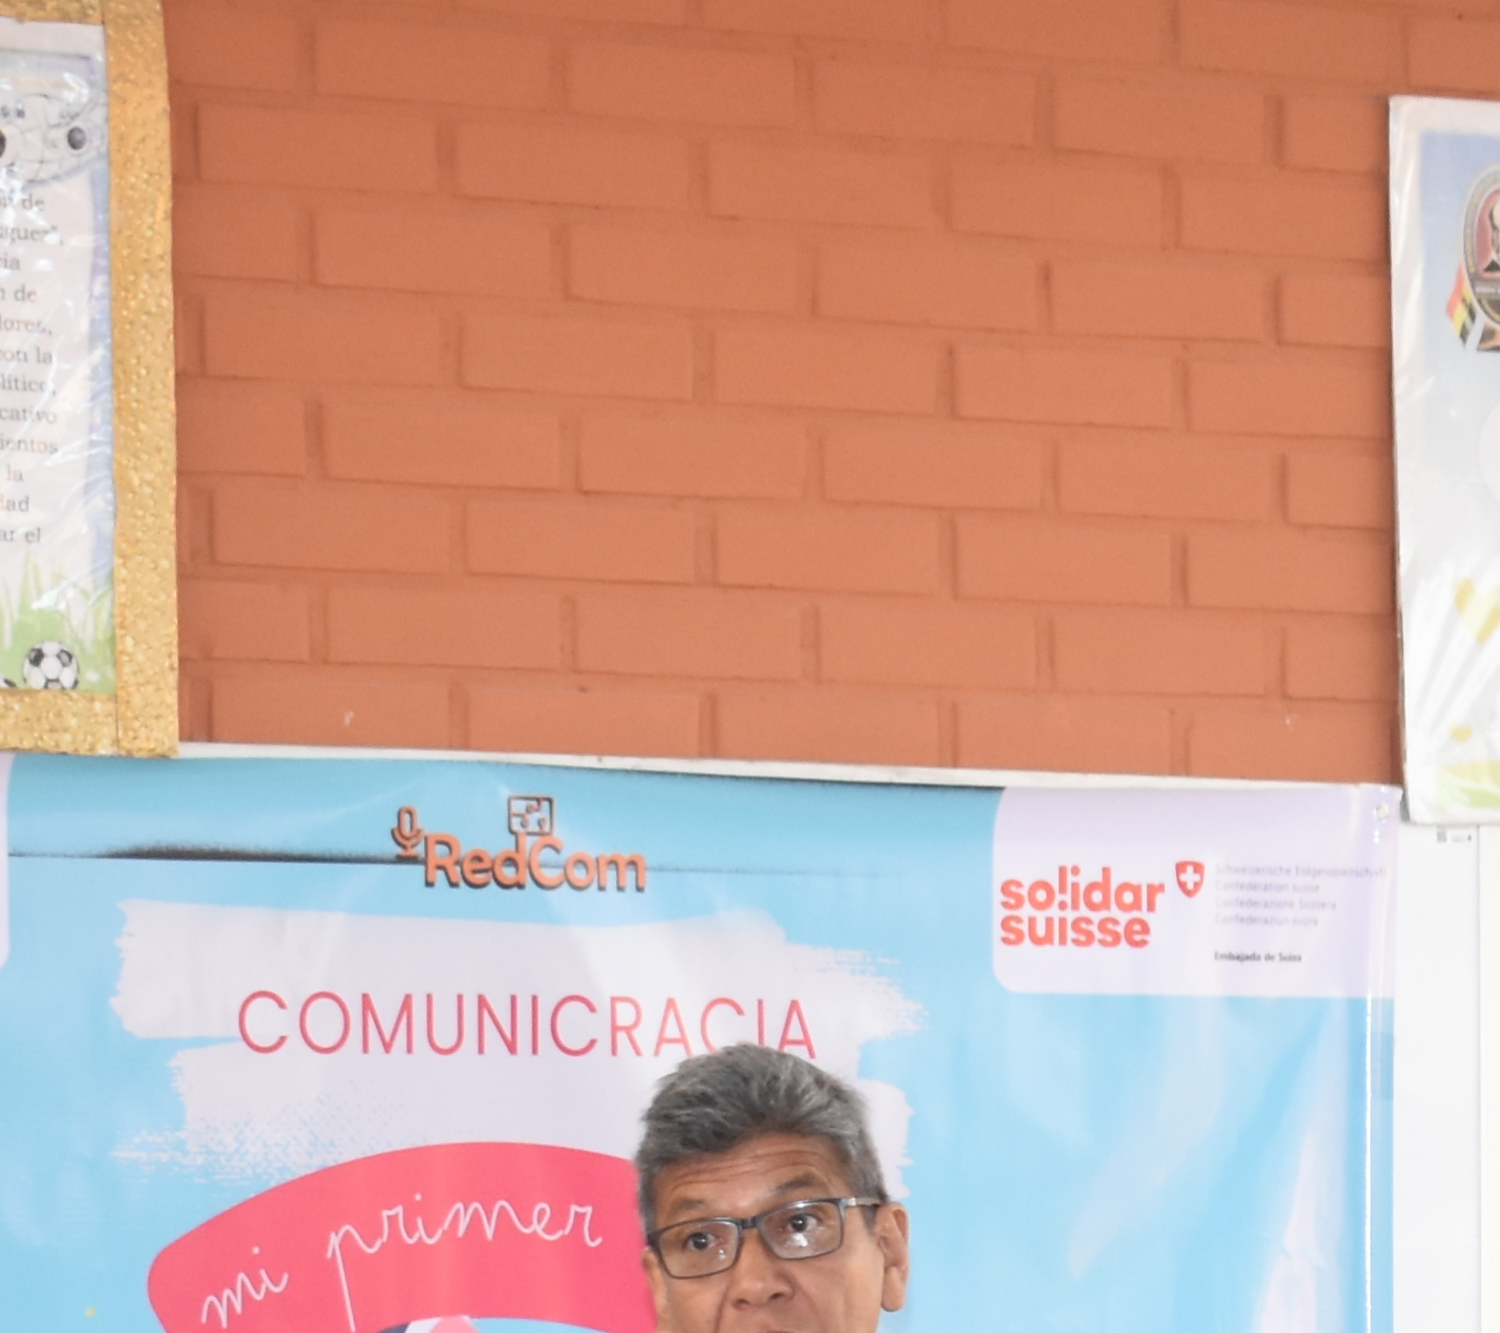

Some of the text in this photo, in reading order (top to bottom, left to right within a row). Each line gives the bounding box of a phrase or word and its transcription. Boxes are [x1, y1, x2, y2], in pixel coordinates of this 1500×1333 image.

[21, 192, 44, 211] de
[14, 285, 37, 303] de
[36, 346, 53, 364] la
[6, 463, 24, 483] la
[25, 527, 42, 544] el
[425, 831, 647, 892] RedCom
[1000, 915, 1151, 949] suisse
[238, 989, 817, 1058] COMUNICRACIA
[200, 1192, 604, 1333] mi primer
